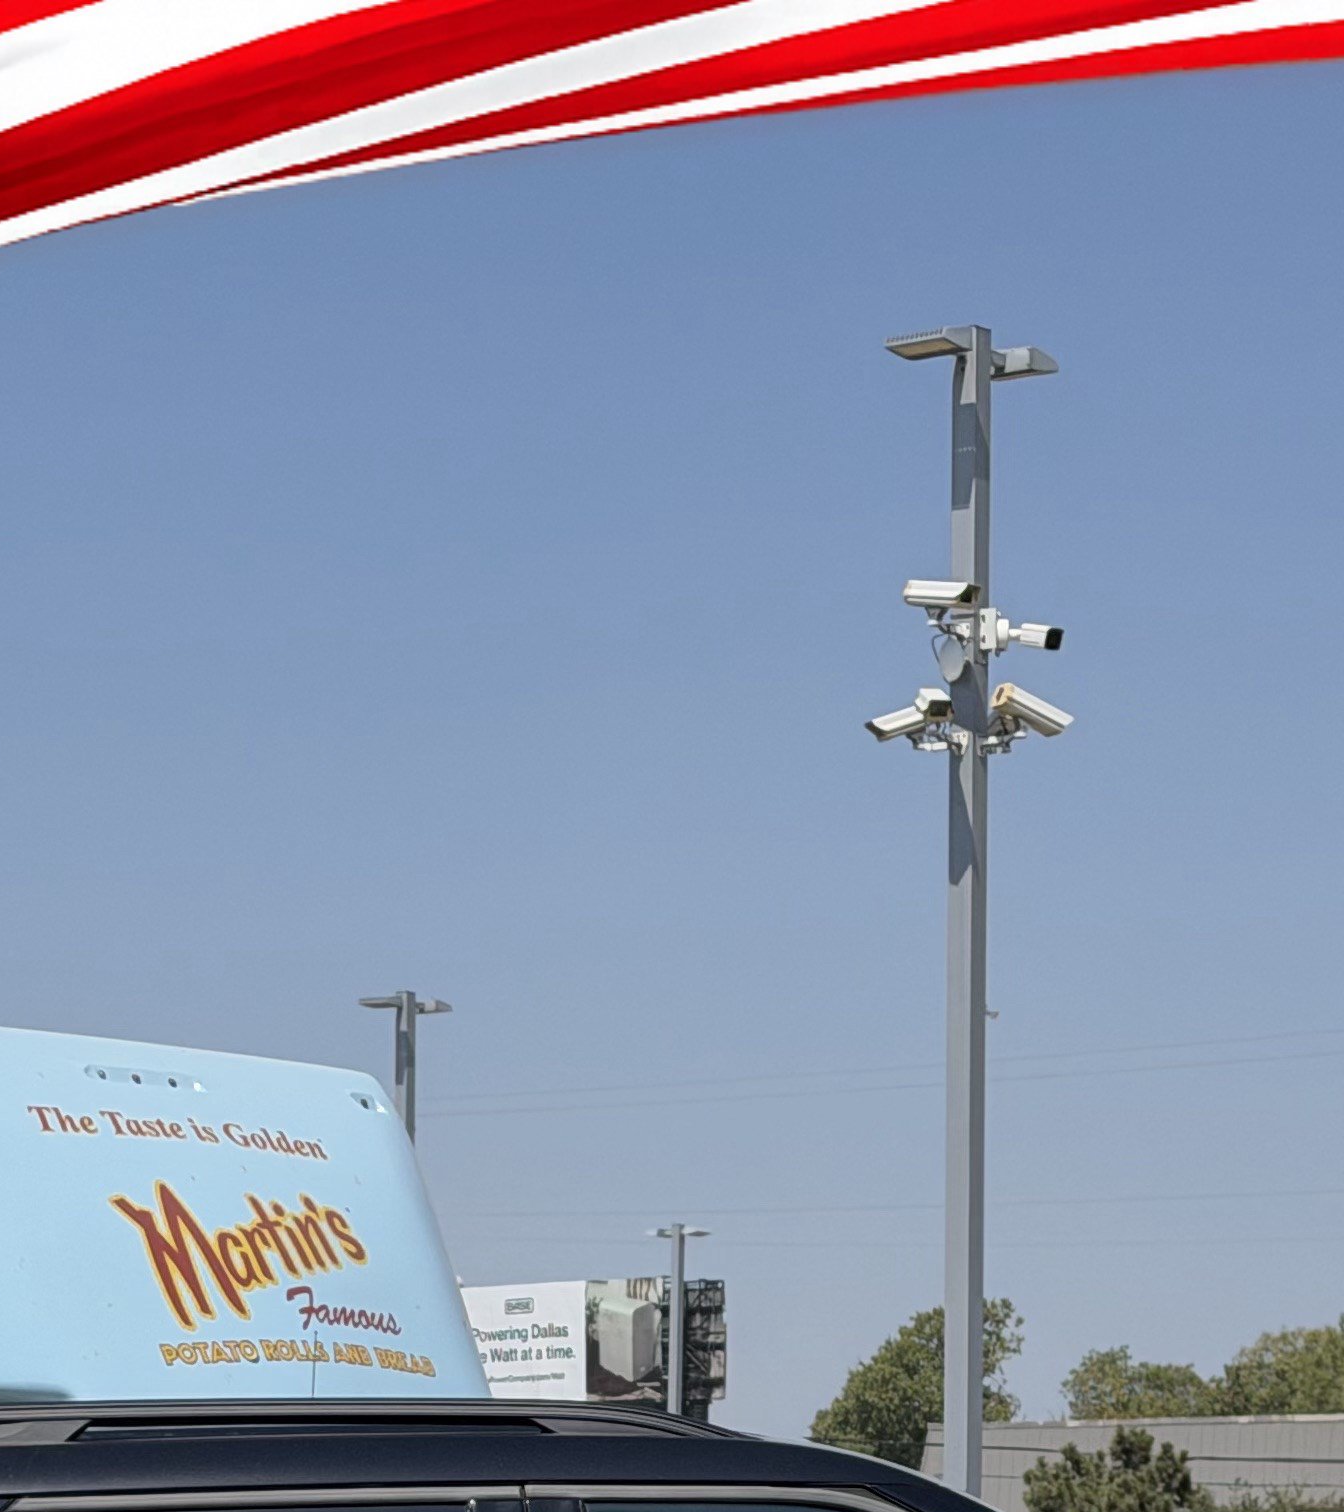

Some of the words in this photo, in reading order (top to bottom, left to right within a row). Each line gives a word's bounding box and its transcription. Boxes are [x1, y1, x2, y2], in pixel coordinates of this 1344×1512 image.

[27, 1105, 97, 1134] The
[99, 1109, 187, 1139] Taste
[187, 1117, 220, 1144] is
[222, 1122, 329, 1160] Golden
[109, 1179, 368, 1332] Martin's
[287, 1285, 402, 1335] Famous
[472, 1326, 529, 1342] Powering
[531, 1323, 569, 1339] Dallas
[490, 1348, 518, 1362] Watt
[521, 1347, 532, 1361] at
[536, 1349, 543, 1360] a
[546, 1345, 576, 1360] time.
[159, 1340, 261, 1366] POTATO
[258, 1339, 330, 1362] ROLLS
[333, 1342, 373, 1367] AND
[373, 1346, 436, 1378] BREAD
